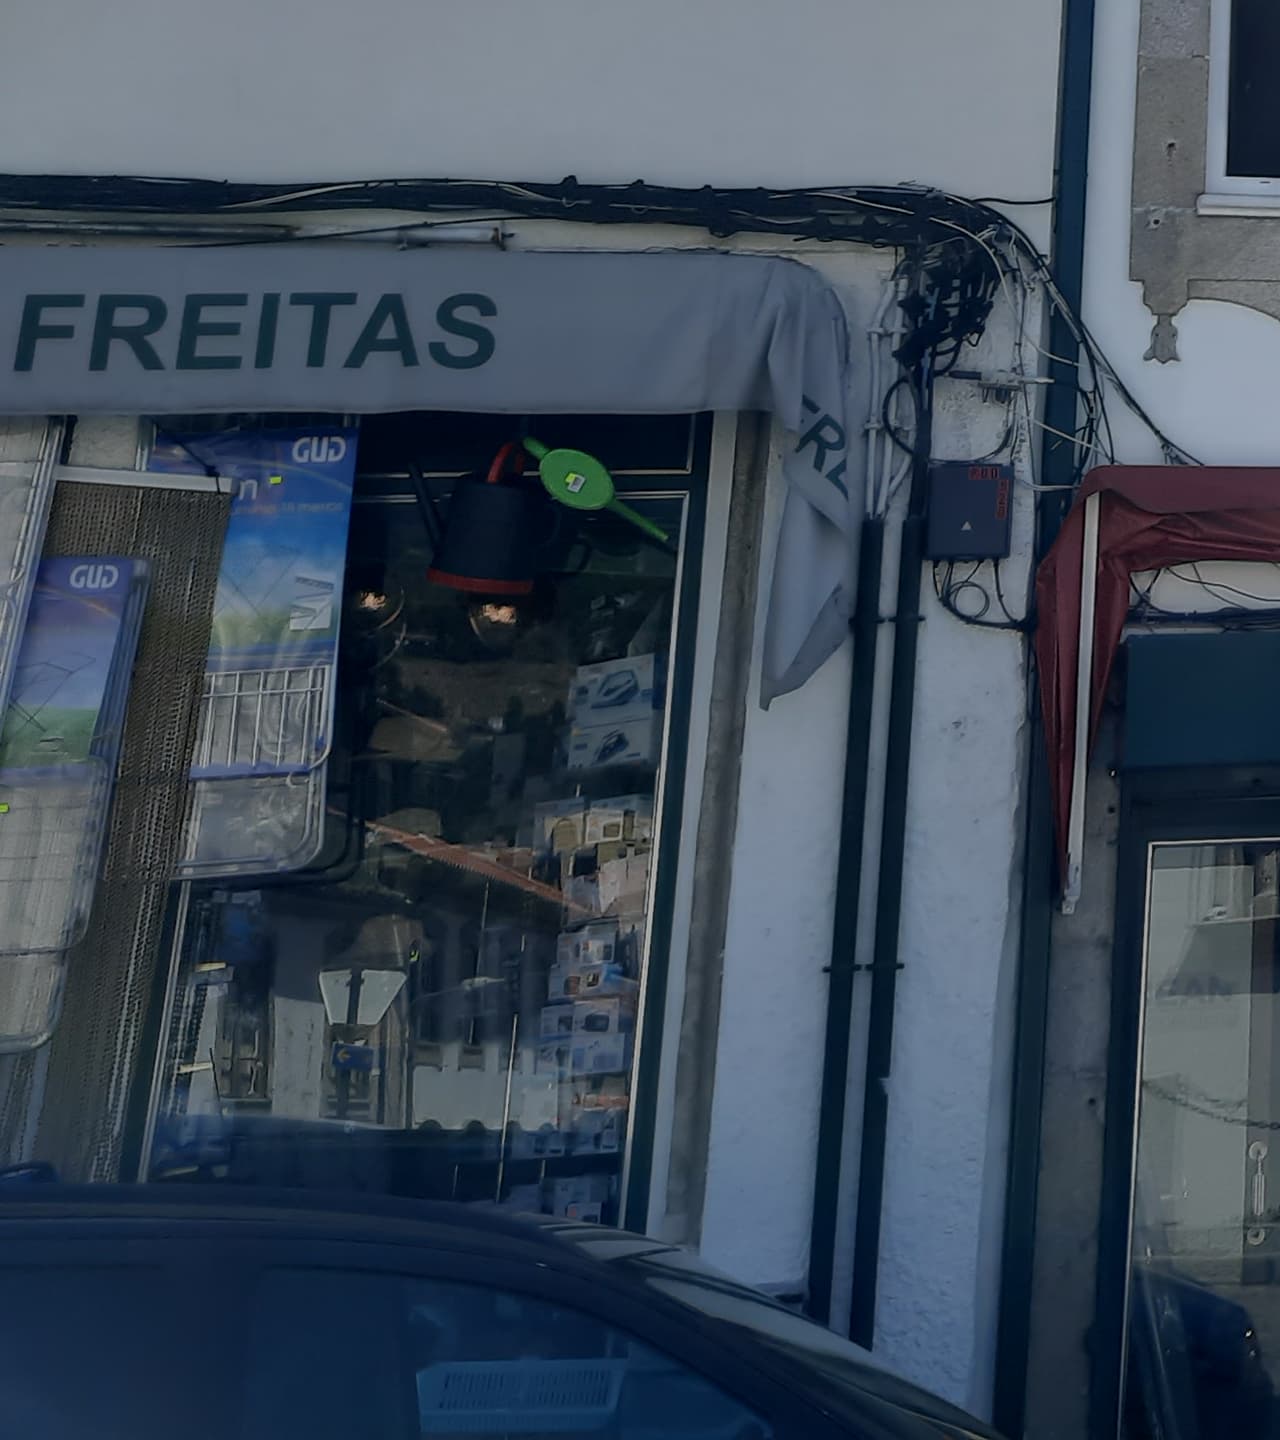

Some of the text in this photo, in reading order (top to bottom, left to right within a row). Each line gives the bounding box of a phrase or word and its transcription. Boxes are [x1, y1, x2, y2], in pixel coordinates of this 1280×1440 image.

[13, 292, 498, 372] FREITAS
[292, 435, 346, 463] GUD
[69, 564, 119, 589] GUD
